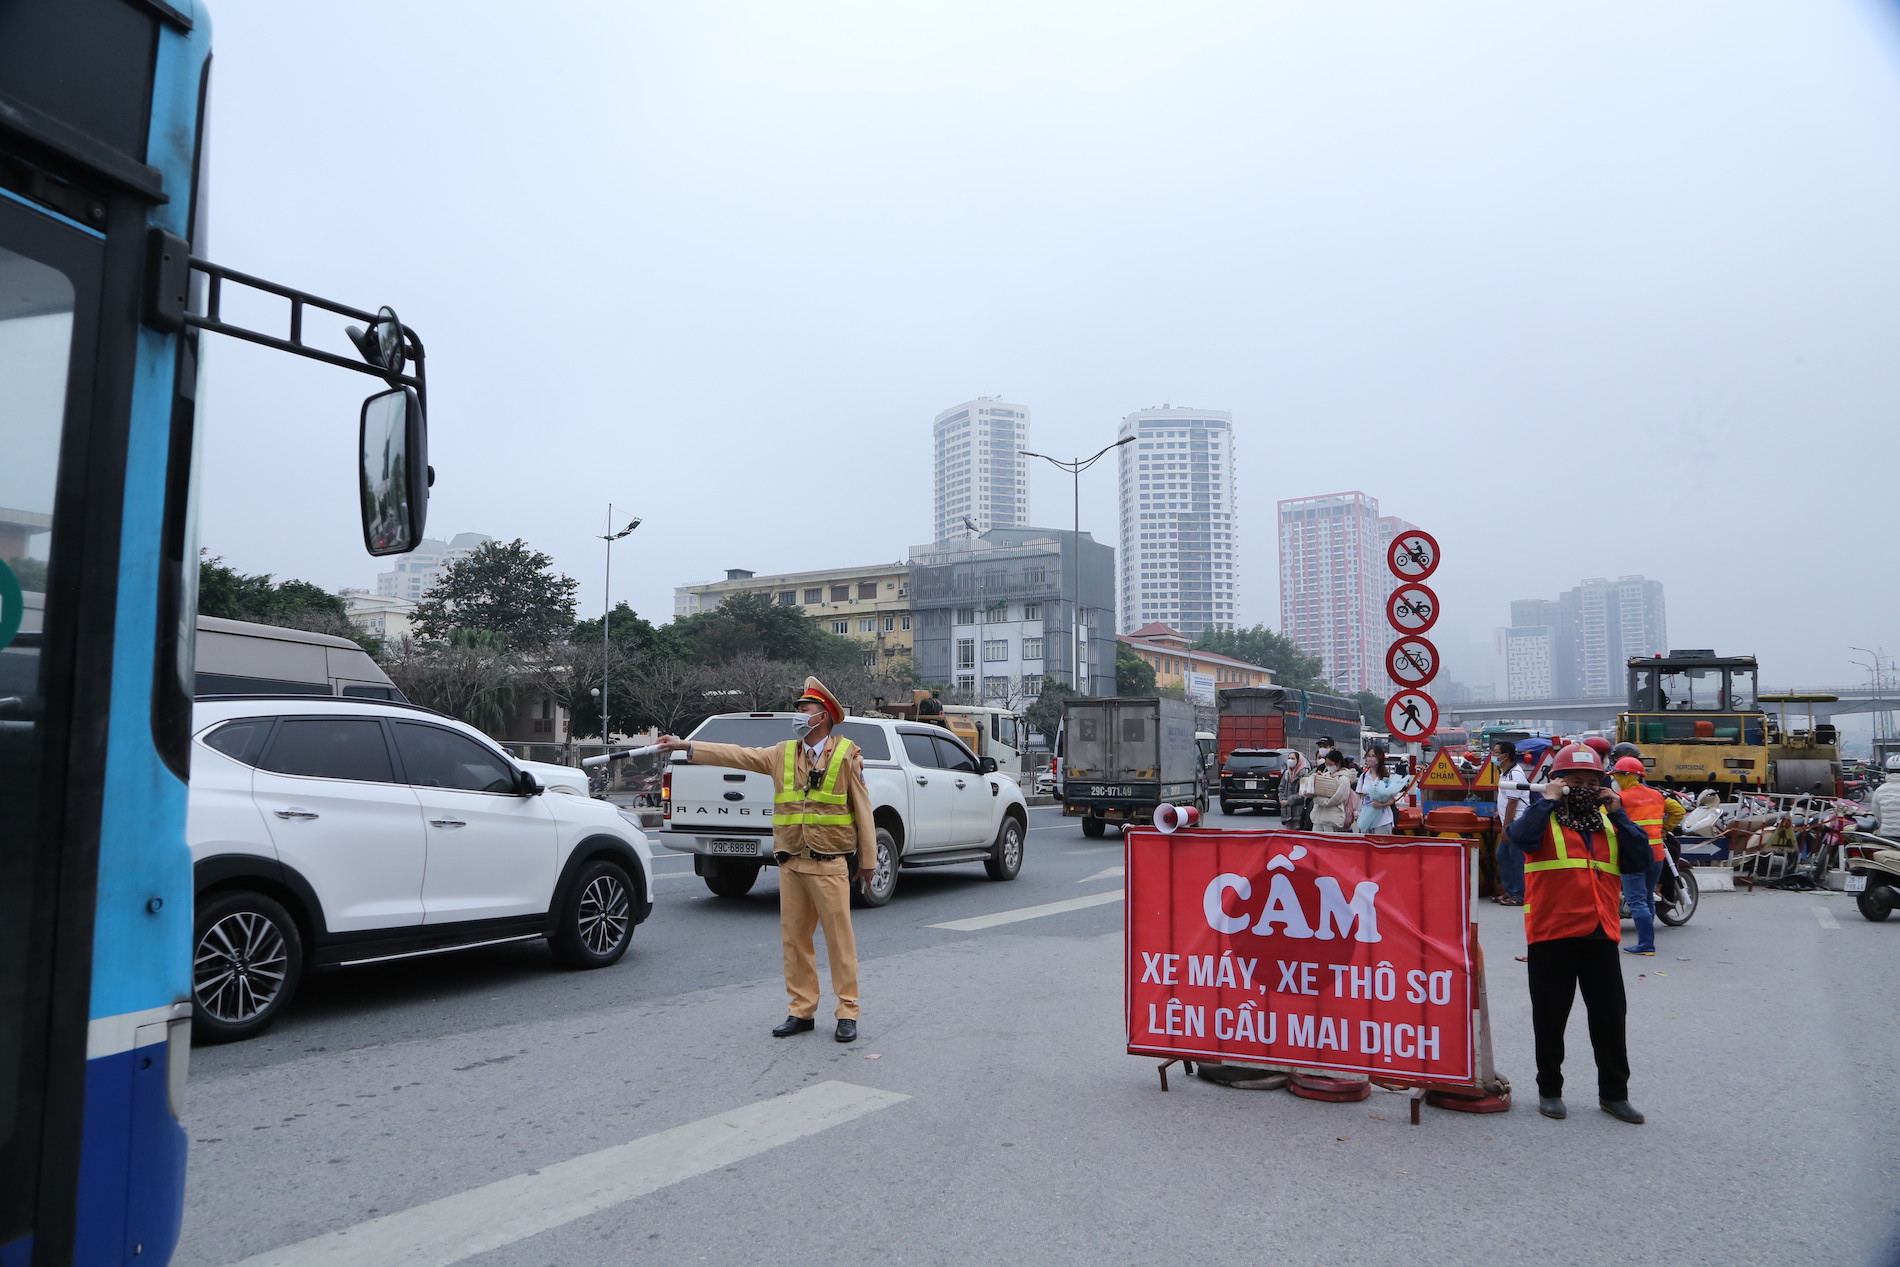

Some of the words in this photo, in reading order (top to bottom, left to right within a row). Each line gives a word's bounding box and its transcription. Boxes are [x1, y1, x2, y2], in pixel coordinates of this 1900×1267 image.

[1430, 771, 1454, 781] CHẬM
[713, 842, 755, 853] 29C-688.99
[1202, 844, 1382, 943] CẤM
[1141, 952, 1179, 986] XE
[1188, 950, 1266, 996] MÁY,
[1276, 960, 1320, 996] XE
[1329, 961, 1396, 1002] THÔ
[1406, 969, 1453, 1005] SƠ
[1148, 997, 1205, 1038] LÊN
[1214, 999, 1277, 1045] CẦU
[1287, 1014, 1349, 1052] MAI
[1360, 1021, 1440, 1063] DỊCH
